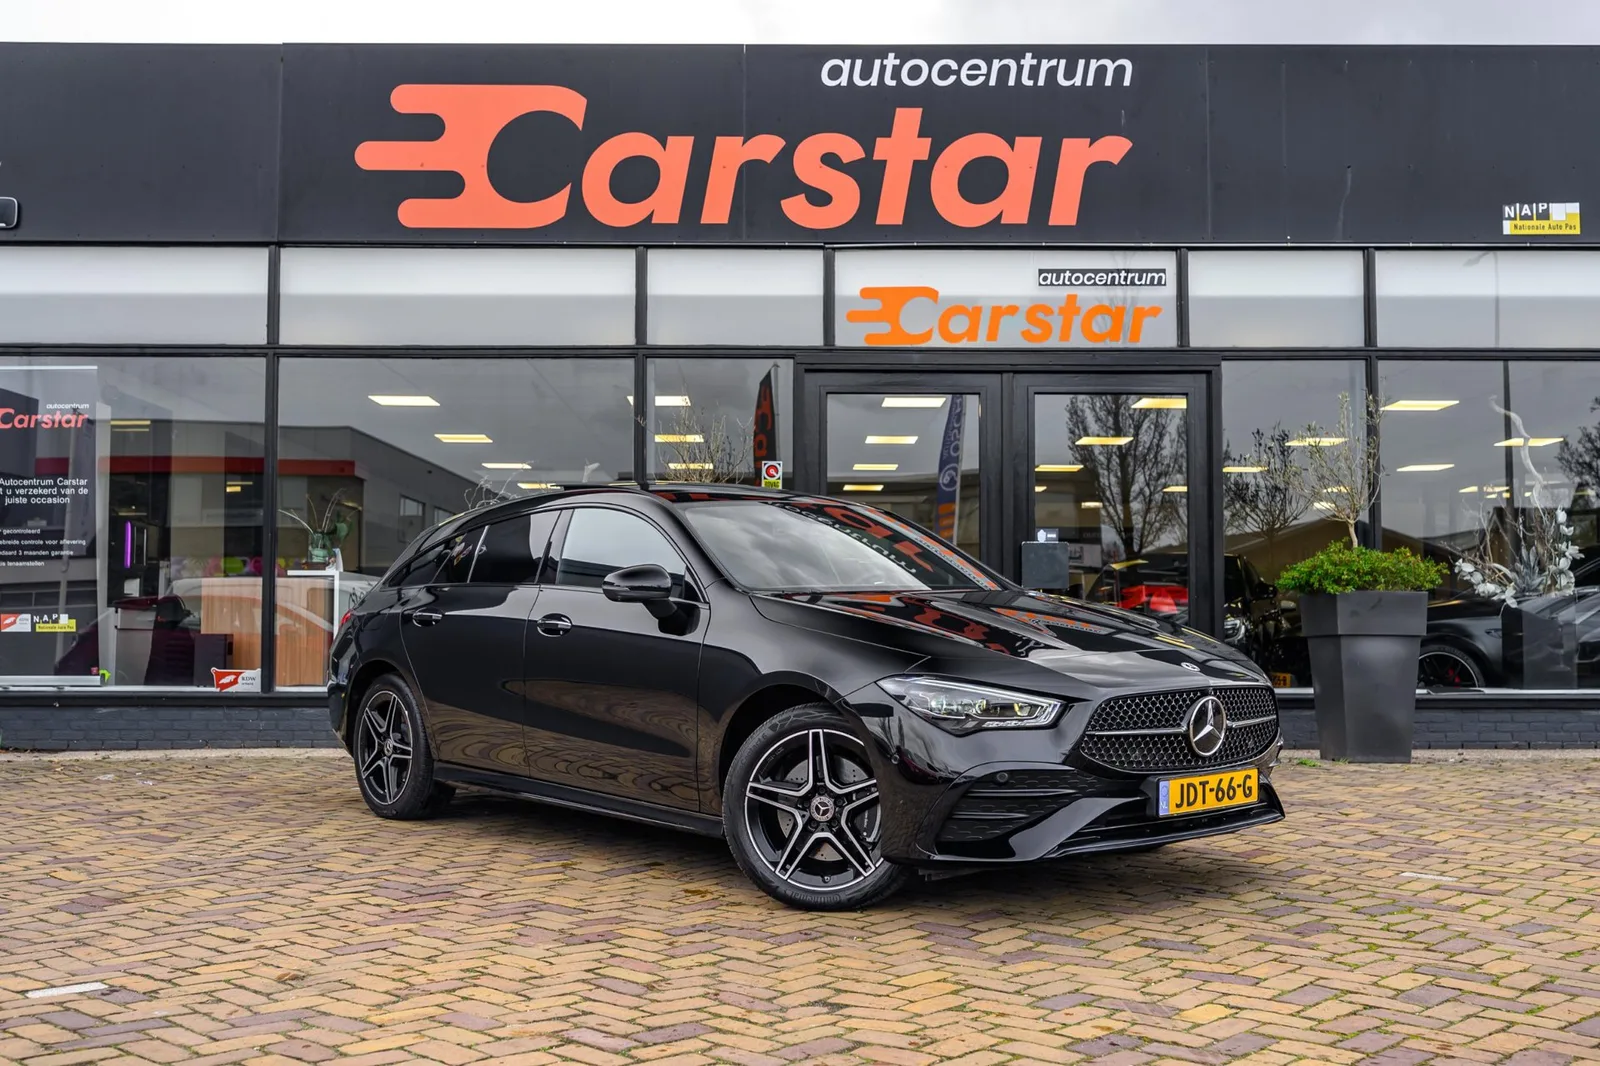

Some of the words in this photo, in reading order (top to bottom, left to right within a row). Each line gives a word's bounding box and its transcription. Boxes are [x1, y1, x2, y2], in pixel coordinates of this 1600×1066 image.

[820, 52, 1133, 88] autocentrum
[354, 83, 1134, 229] Carstar
[1513, 223, 1546, 231] Nationale
[1547, 223, 1563, 231] Auto
[1565, 223, 1577, 231] Pas
[1038, 269, 1167, 286] autocentrum
[846, 286, 1163, 346] Carstar
[0, 407, 89, 429] Carstar
[0, 477, 54, 486] Autocentrum
[57, 477, 88, 486] Carstar
[15, 487, 57, 495] verzekerd
[78, 487, 89, 495] de
[5, 496, 28, 505] juiste
[30, 496, 70, 504] occasion
[1175, 774, 1253, 809] JDT-66-G
